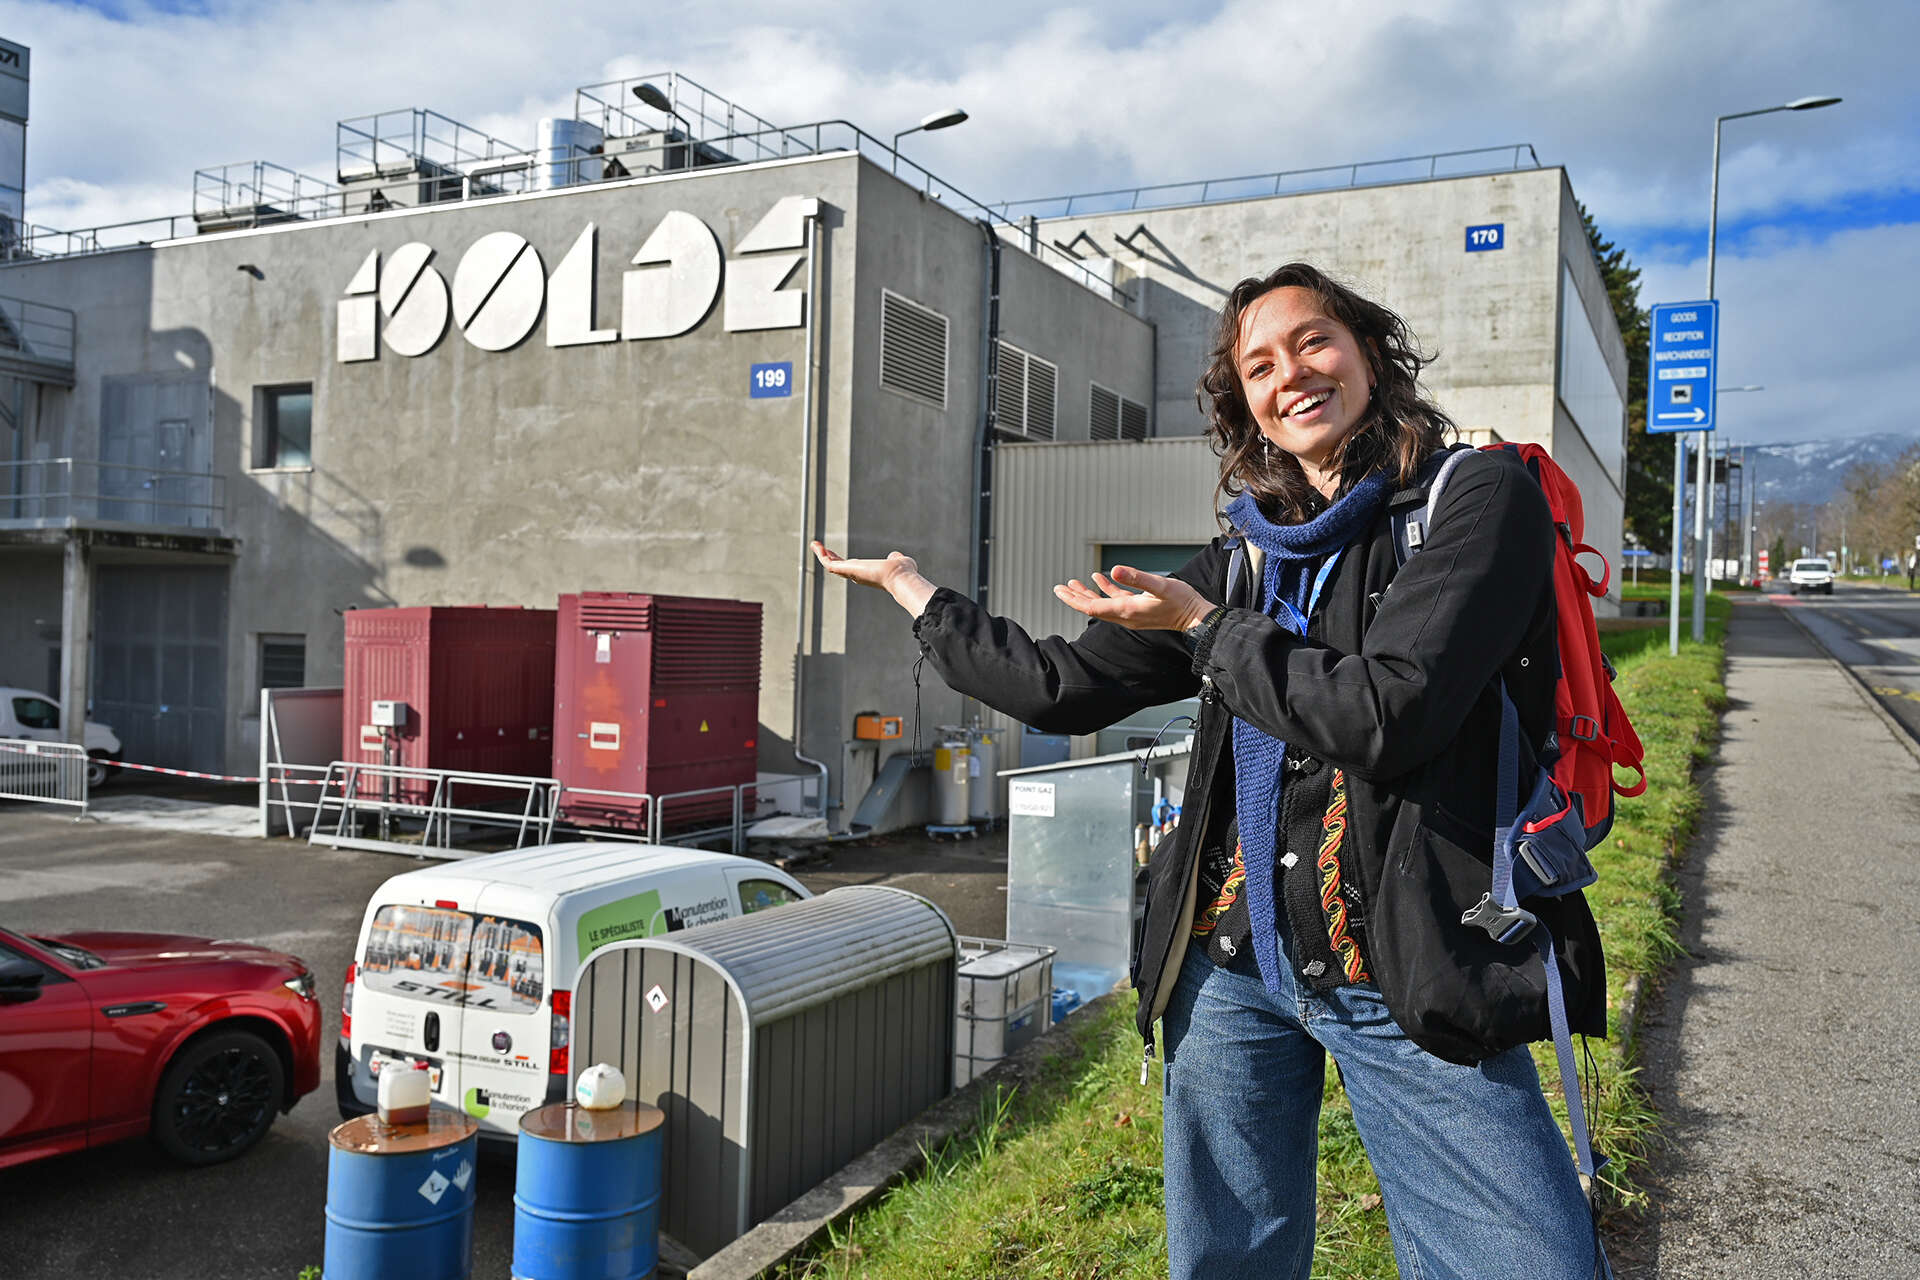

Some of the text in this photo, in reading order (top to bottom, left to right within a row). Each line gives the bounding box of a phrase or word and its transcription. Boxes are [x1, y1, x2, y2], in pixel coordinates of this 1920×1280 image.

[1471, 229, 1498, 245] 170
[1671, 311, 1698, 323] GOODS
[1663, 331, 1704, 342] RECEPTION
[1656, 348, 1712, 361] MARCHANDISES
[756, 368, 786, 388] 199
[671, 897, 728, 923] Manutention
[588, 919, 645, 942] LE SPÉCIALISTE
[392, 980, 497, 1010] STILL
[504, 1059, 540, 1070] STILL
[481, 1088, 531, 1103] Manutention
